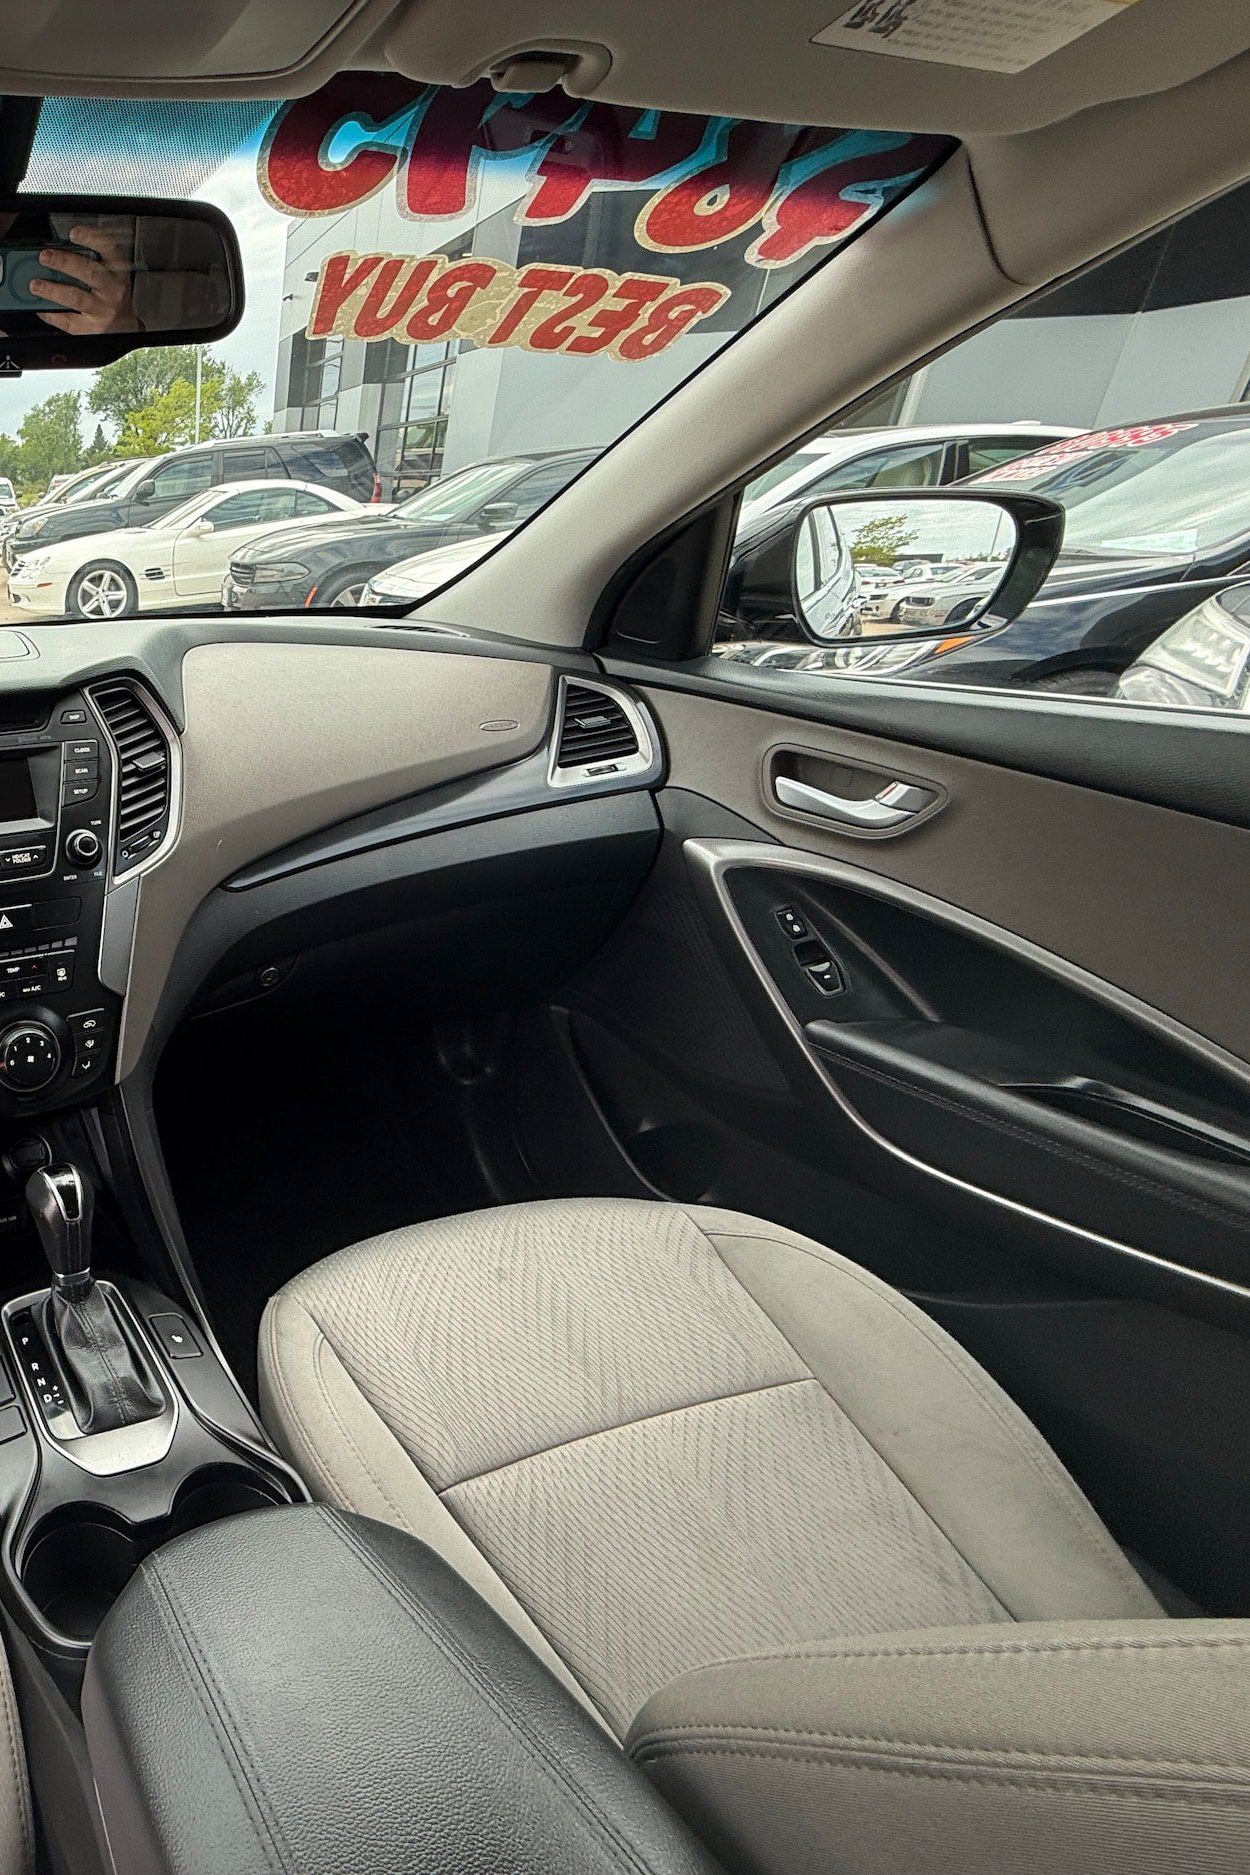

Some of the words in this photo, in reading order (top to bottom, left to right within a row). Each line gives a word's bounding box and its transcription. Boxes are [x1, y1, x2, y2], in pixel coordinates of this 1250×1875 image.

[30, 984, 42, 992] A/C
[21, 1337, 29, 1345] P
[31, 1362, 39, 1371] R
[36, 1377, 46, 1387] N
[43, 1393, 53, 1403] D
